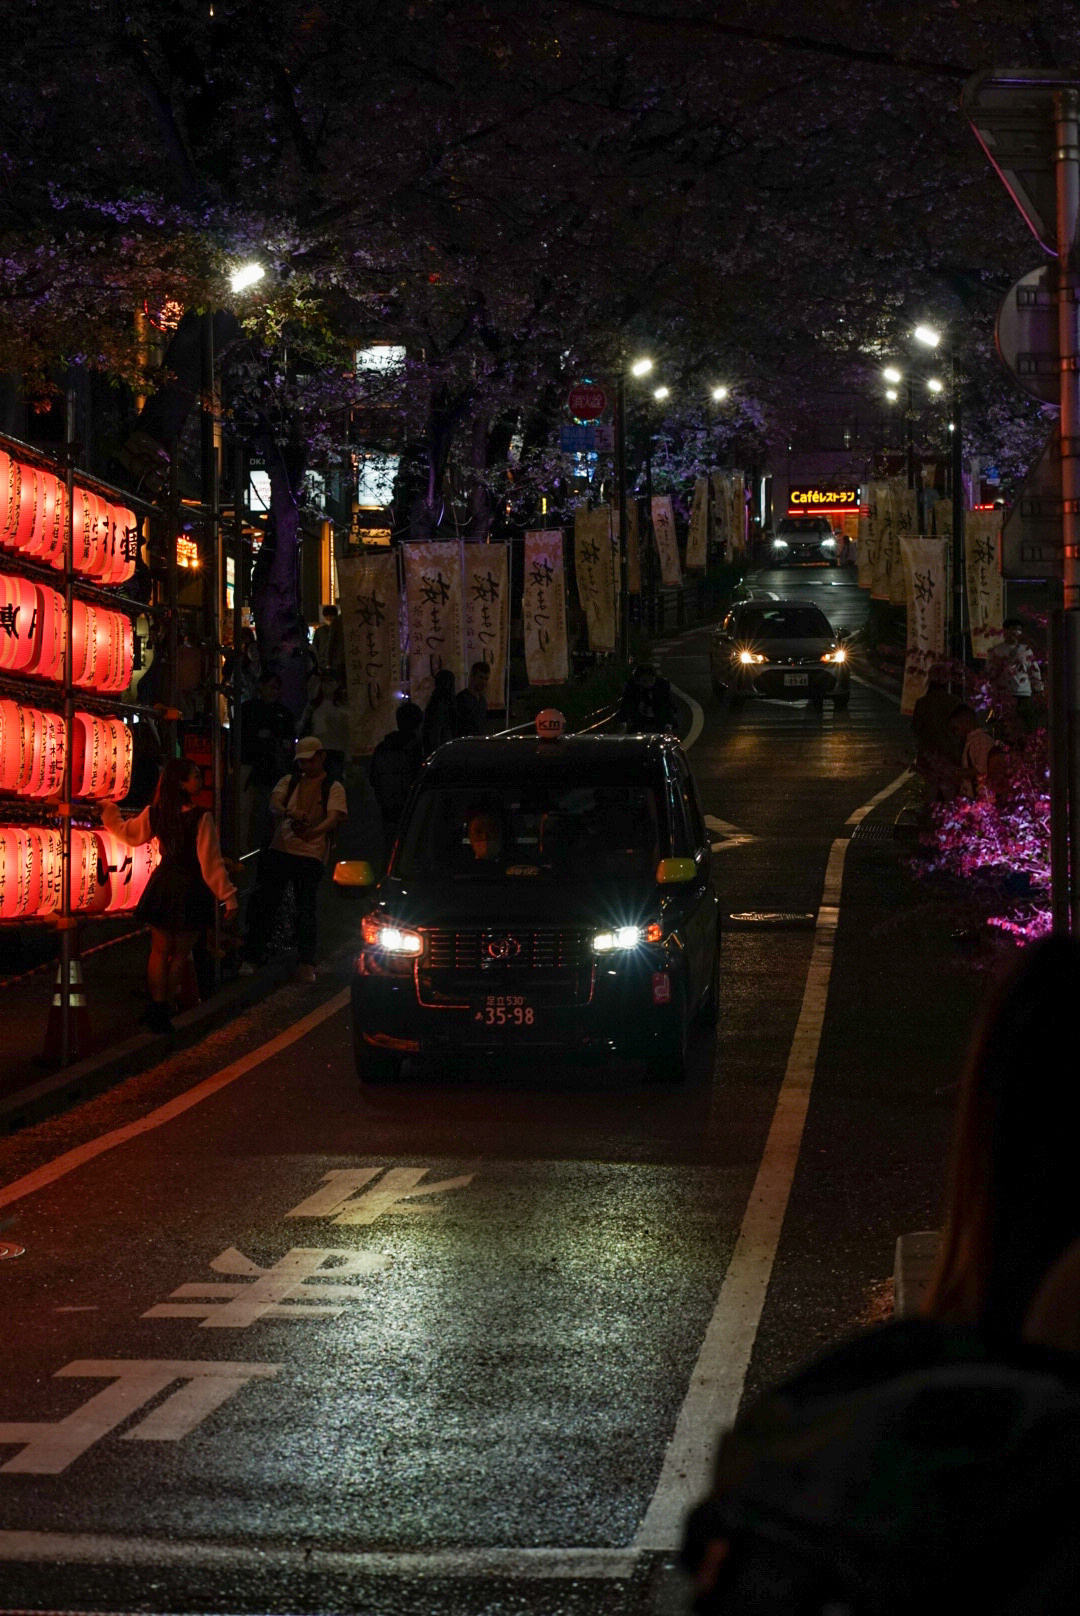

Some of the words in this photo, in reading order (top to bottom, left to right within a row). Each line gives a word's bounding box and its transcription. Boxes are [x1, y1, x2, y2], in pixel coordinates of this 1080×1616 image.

[791, 490, 855, 504] Caféレストラン
[485, 1007, 535, 1025] 35-98
